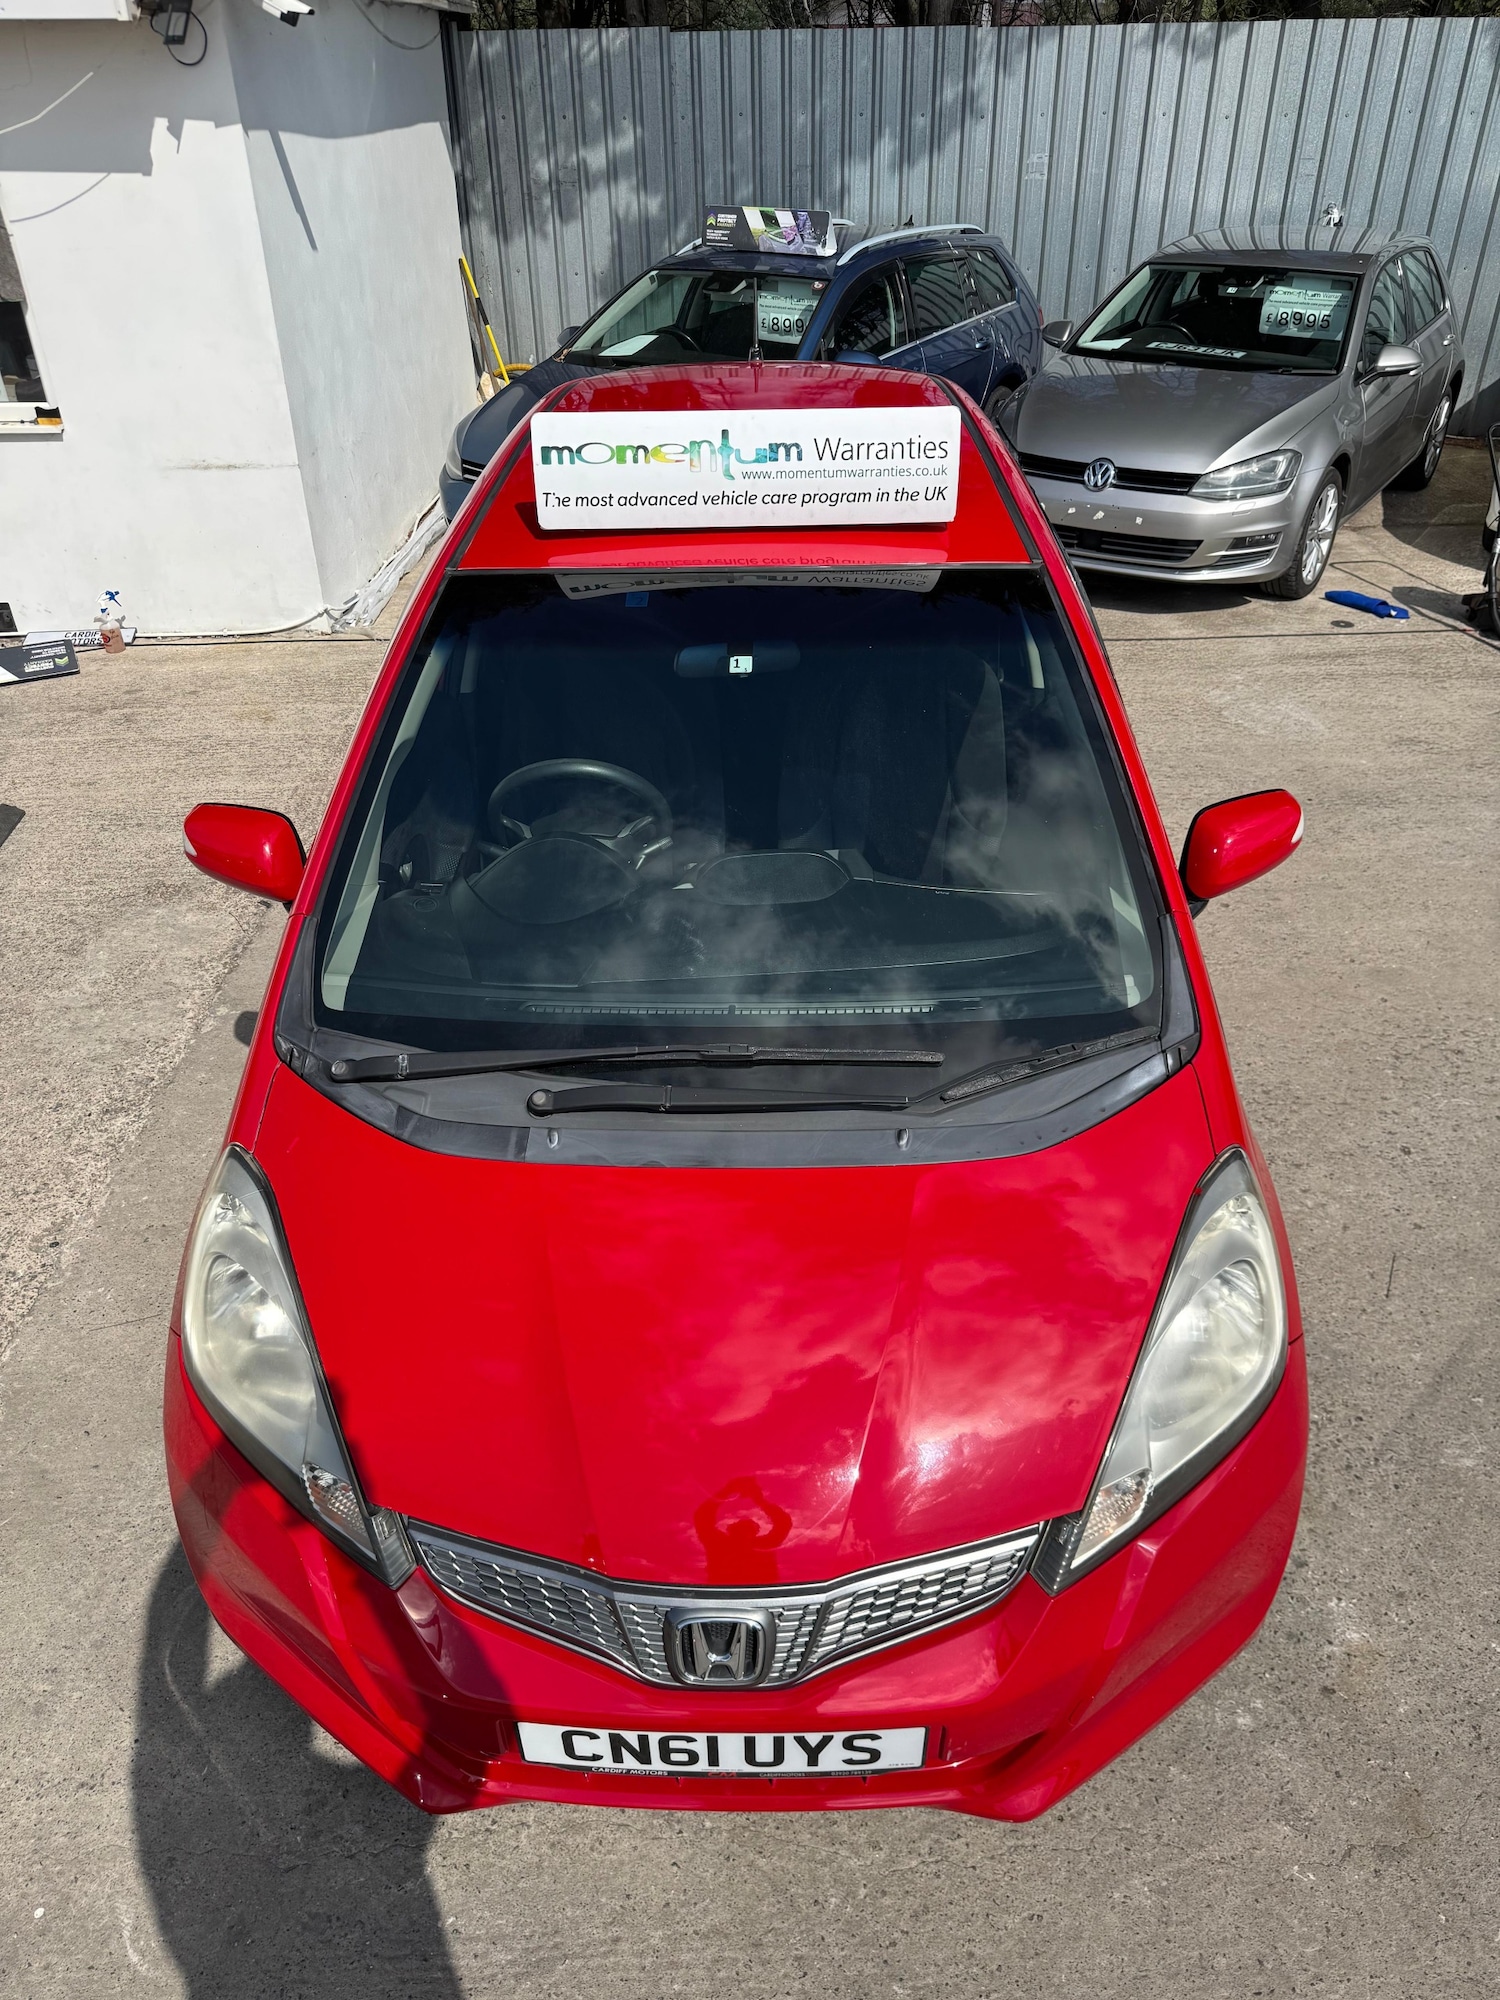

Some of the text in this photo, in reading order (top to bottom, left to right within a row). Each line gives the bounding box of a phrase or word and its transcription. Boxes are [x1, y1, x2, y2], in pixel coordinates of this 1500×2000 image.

[761, 316, 805, 333] £899
[541, 429, 949, 481] momentum Warranties
[741, 464, 949, 481] www.momentumwarranties.co.uk
[542, 485, 948, 509] The most advanced vehicle care program in the UK
[64, 630, 102, 639] CARDIF
[71, 636, 104, 646] OTORS
[733, 658, 741, 669] 1
[561, 1729, 882, 1768] CN61 UYS
[591, 1766, 627, 1774] CARDIFF
